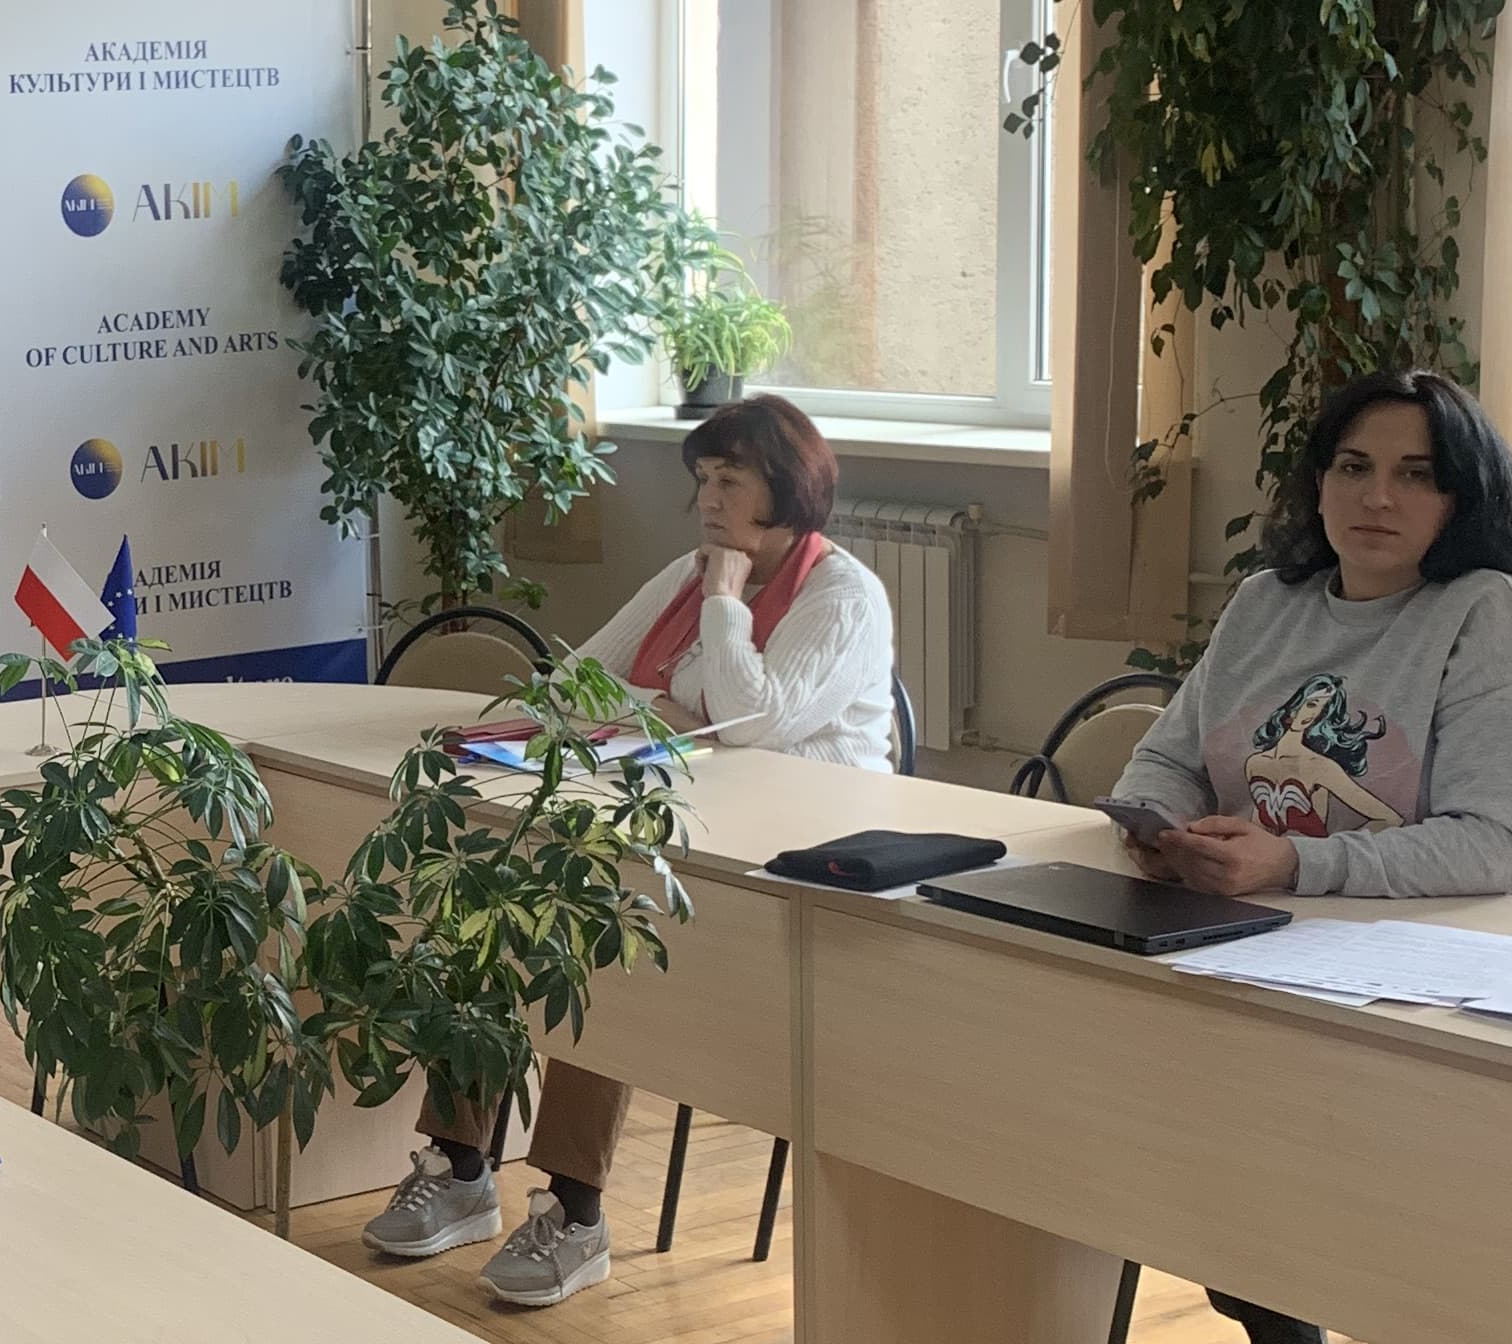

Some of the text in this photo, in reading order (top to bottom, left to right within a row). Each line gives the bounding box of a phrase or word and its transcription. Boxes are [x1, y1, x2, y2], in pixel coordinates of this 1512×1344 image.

[84, 39, 208, 64] АКАДЕМІЯ
[9, 71, 132, 94] КУЛЬТУРИ
[153, 67, 280, 92] МИСТЕЦТВ
[97, 307, 211, 335] ACADEMY
[25, 330, 279, 369] OF CULTURE AND ARTS
[134, 559, 222, 588] АДЕМІЯ
[168, 580, 293, 611] МИСТЕЦТВ
